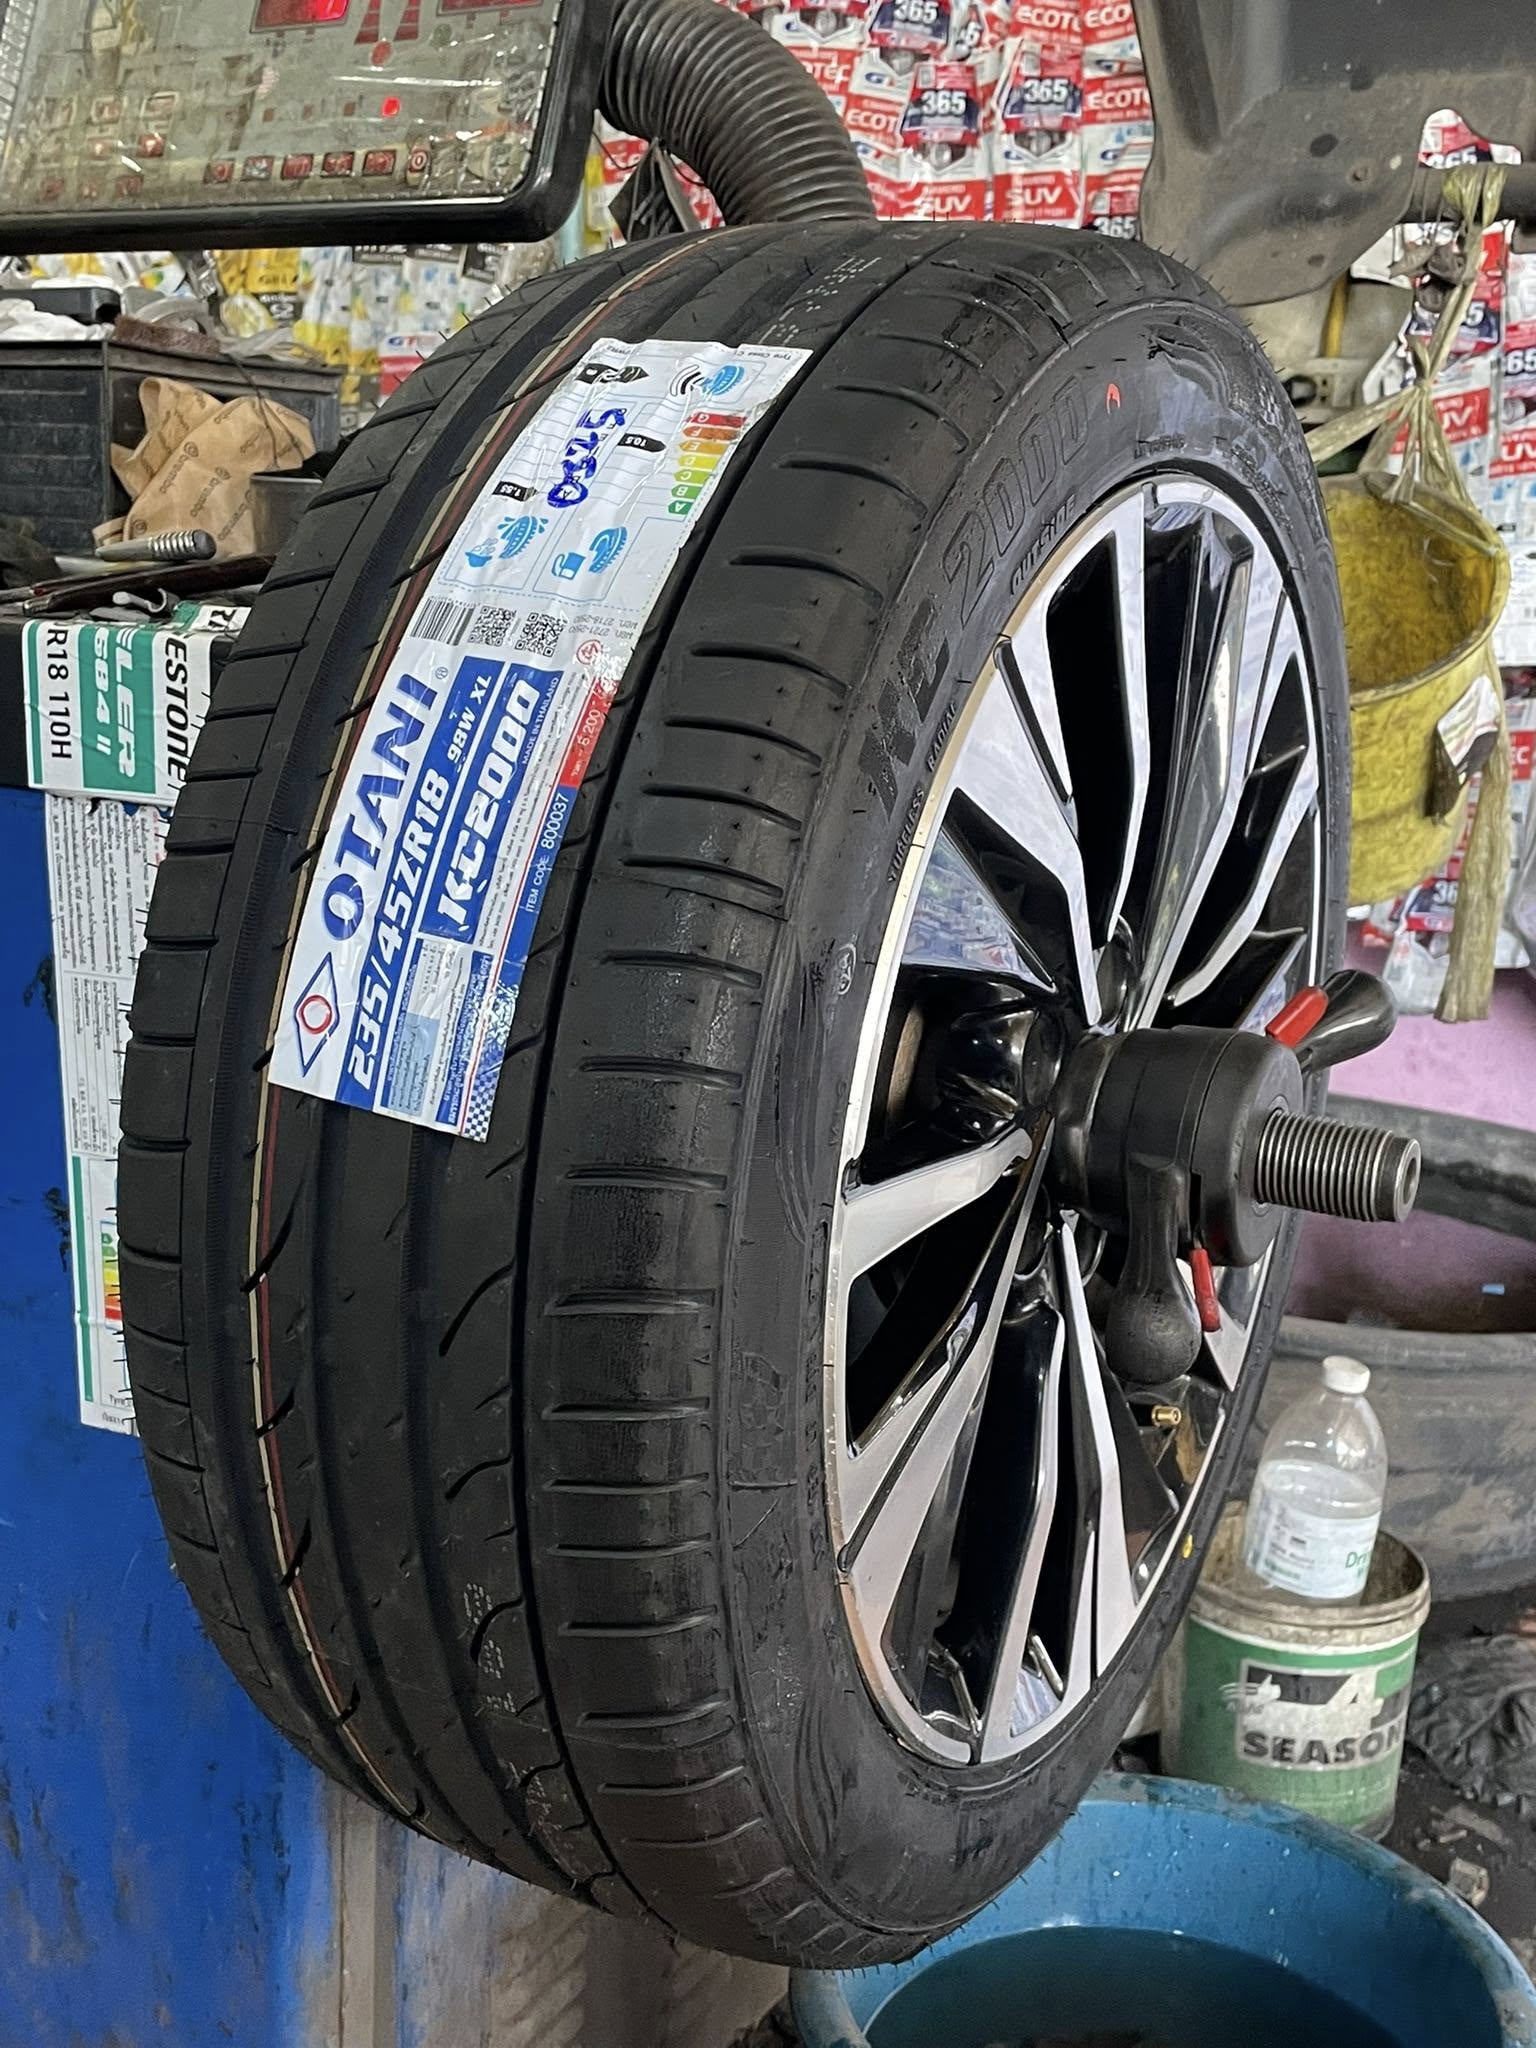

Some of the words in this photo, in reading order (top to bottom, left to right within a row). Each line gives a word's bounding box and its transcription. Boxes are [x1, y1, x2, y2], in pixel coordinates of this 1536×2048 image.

[894, 0, 939, 24] 365
[1084, 4, 1132, 29] ECO
[921, 89, 967, 116] 365
[1023, 78, 1070, 103] 365
[1004, 186, 1063, 207] SUV
[675, 502, 685, 513] A
[677, 486, 687, 496] B
[47, 620, 70, 681] R18
[49, 691, 73, 760] 110H
[164, 636, 191, 787] ESTONE
[323, 673, 439, 941] OTANI
[437, 679, 542, 926] KC2000
[524, 888, 541, 913] ITEM
[540, 792, 570, 850] 800037
[347, 768, 450, 1090] 235/45ZR18
[446, 706, 476, 766] 98W
[469, 673, 492, 705] XL
